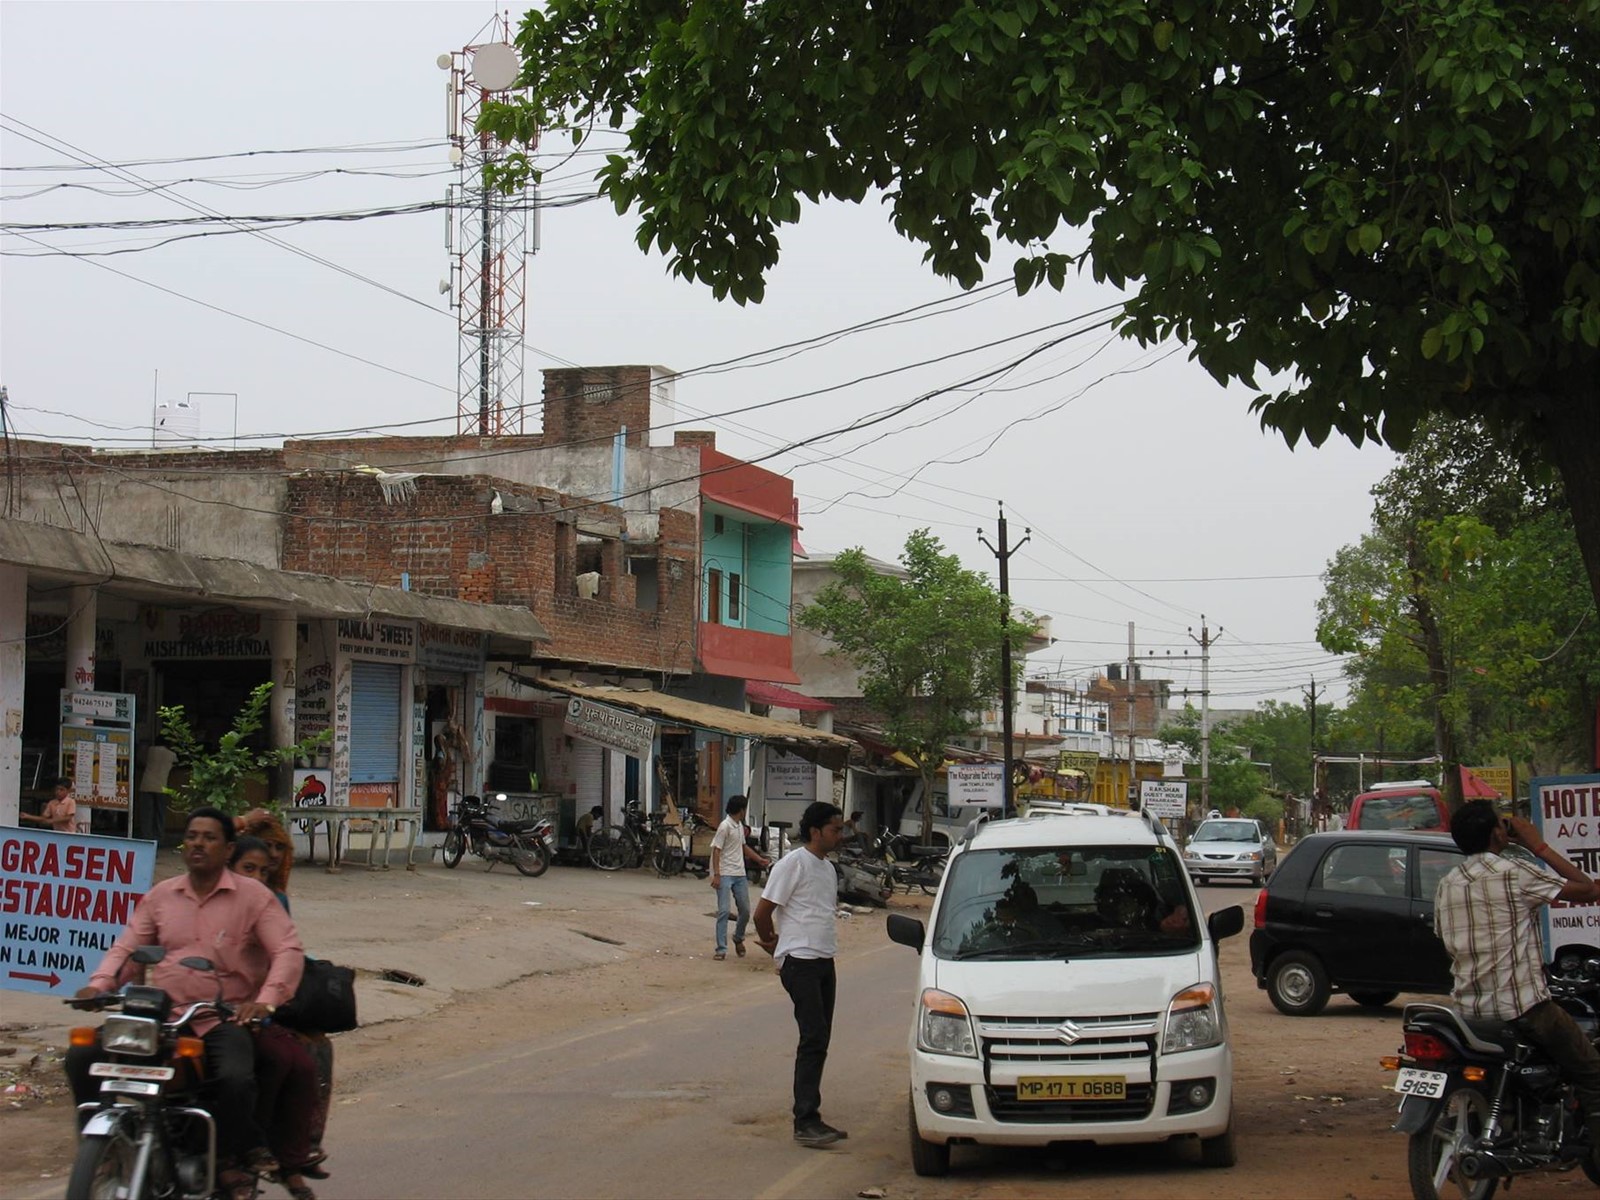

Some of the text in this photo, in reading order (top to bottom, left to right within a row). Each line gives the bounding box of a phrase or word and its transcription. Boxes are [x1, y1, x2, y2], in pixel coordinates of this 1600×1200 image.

[338, 619, 413, 646] PANKAJ SWEETS
[218, 639, 272, 657] BHANDA
[1557, 821, 1588, 838] A/C
[1, 838, 135, 885] GRASEN
[0, 878, 145, 926] STAURANT
[5, 922, 60, 945] MEJOR
[17, 948, 37, 967] LA
[42, 951, 86, 974] INDIA
[1020, 1082, 1124, 1095] MP 17 T 0688
[1400, 1079, 1440, 1096] 9185
